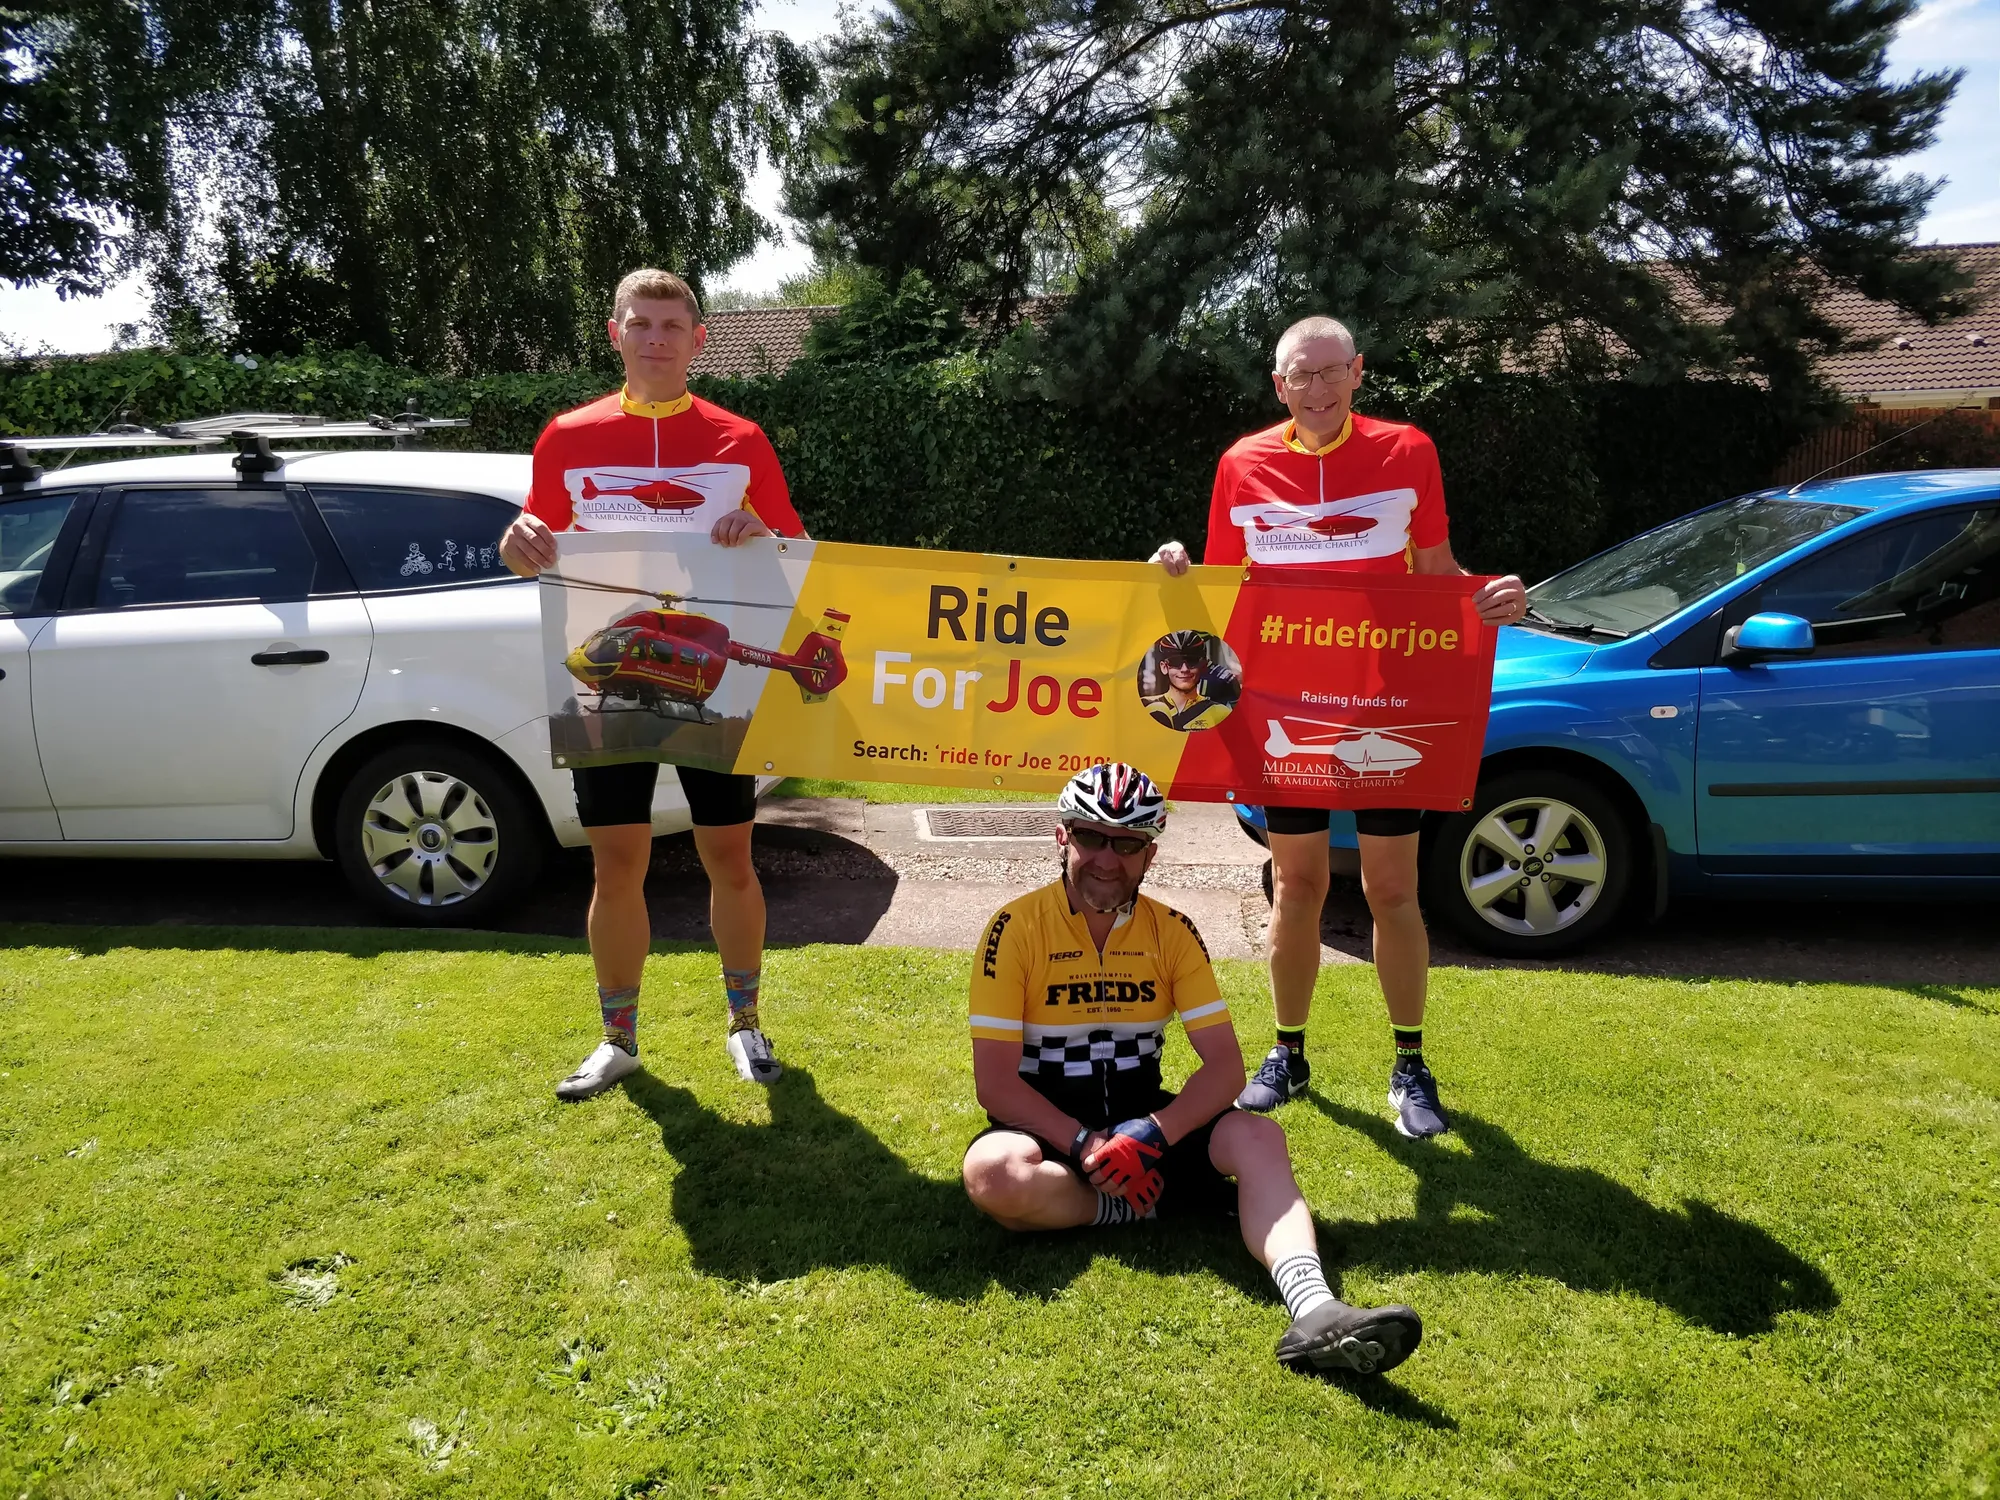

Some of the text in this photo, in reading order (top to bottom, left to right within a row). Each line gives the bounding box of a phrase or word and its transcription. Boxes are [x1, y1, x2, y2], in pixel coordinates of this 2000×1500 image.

[583, 502, 643, 512] MIDLANDS
[595, 513, 647, 522] AMBULANCE
[1255, 532, 1318, 544] MIDLANDS
[1269, 543, 1322, 552] AMBULANCE
[927, 585, 1069, 646] Ride
[1260, 615, 1458, 656] #rideforjoe
[872, 651, 1102, 719] For Joe
[1301, 691, 1408, 708] Raising funds for
[853, 740, 928, 762] Search:
[984, 749, 1013, 767] for
[1018, 752, 1052, 770] Joe
[1263, 760, 1346, 776] MIDLANDS
[1262, 775, 1281, 785] AIR
[1284, 776, 1351, 789] AMBULANCE
[983, 911, 1012, 980] FREDS
[1045, 980, 1157, 1006] FREDS
